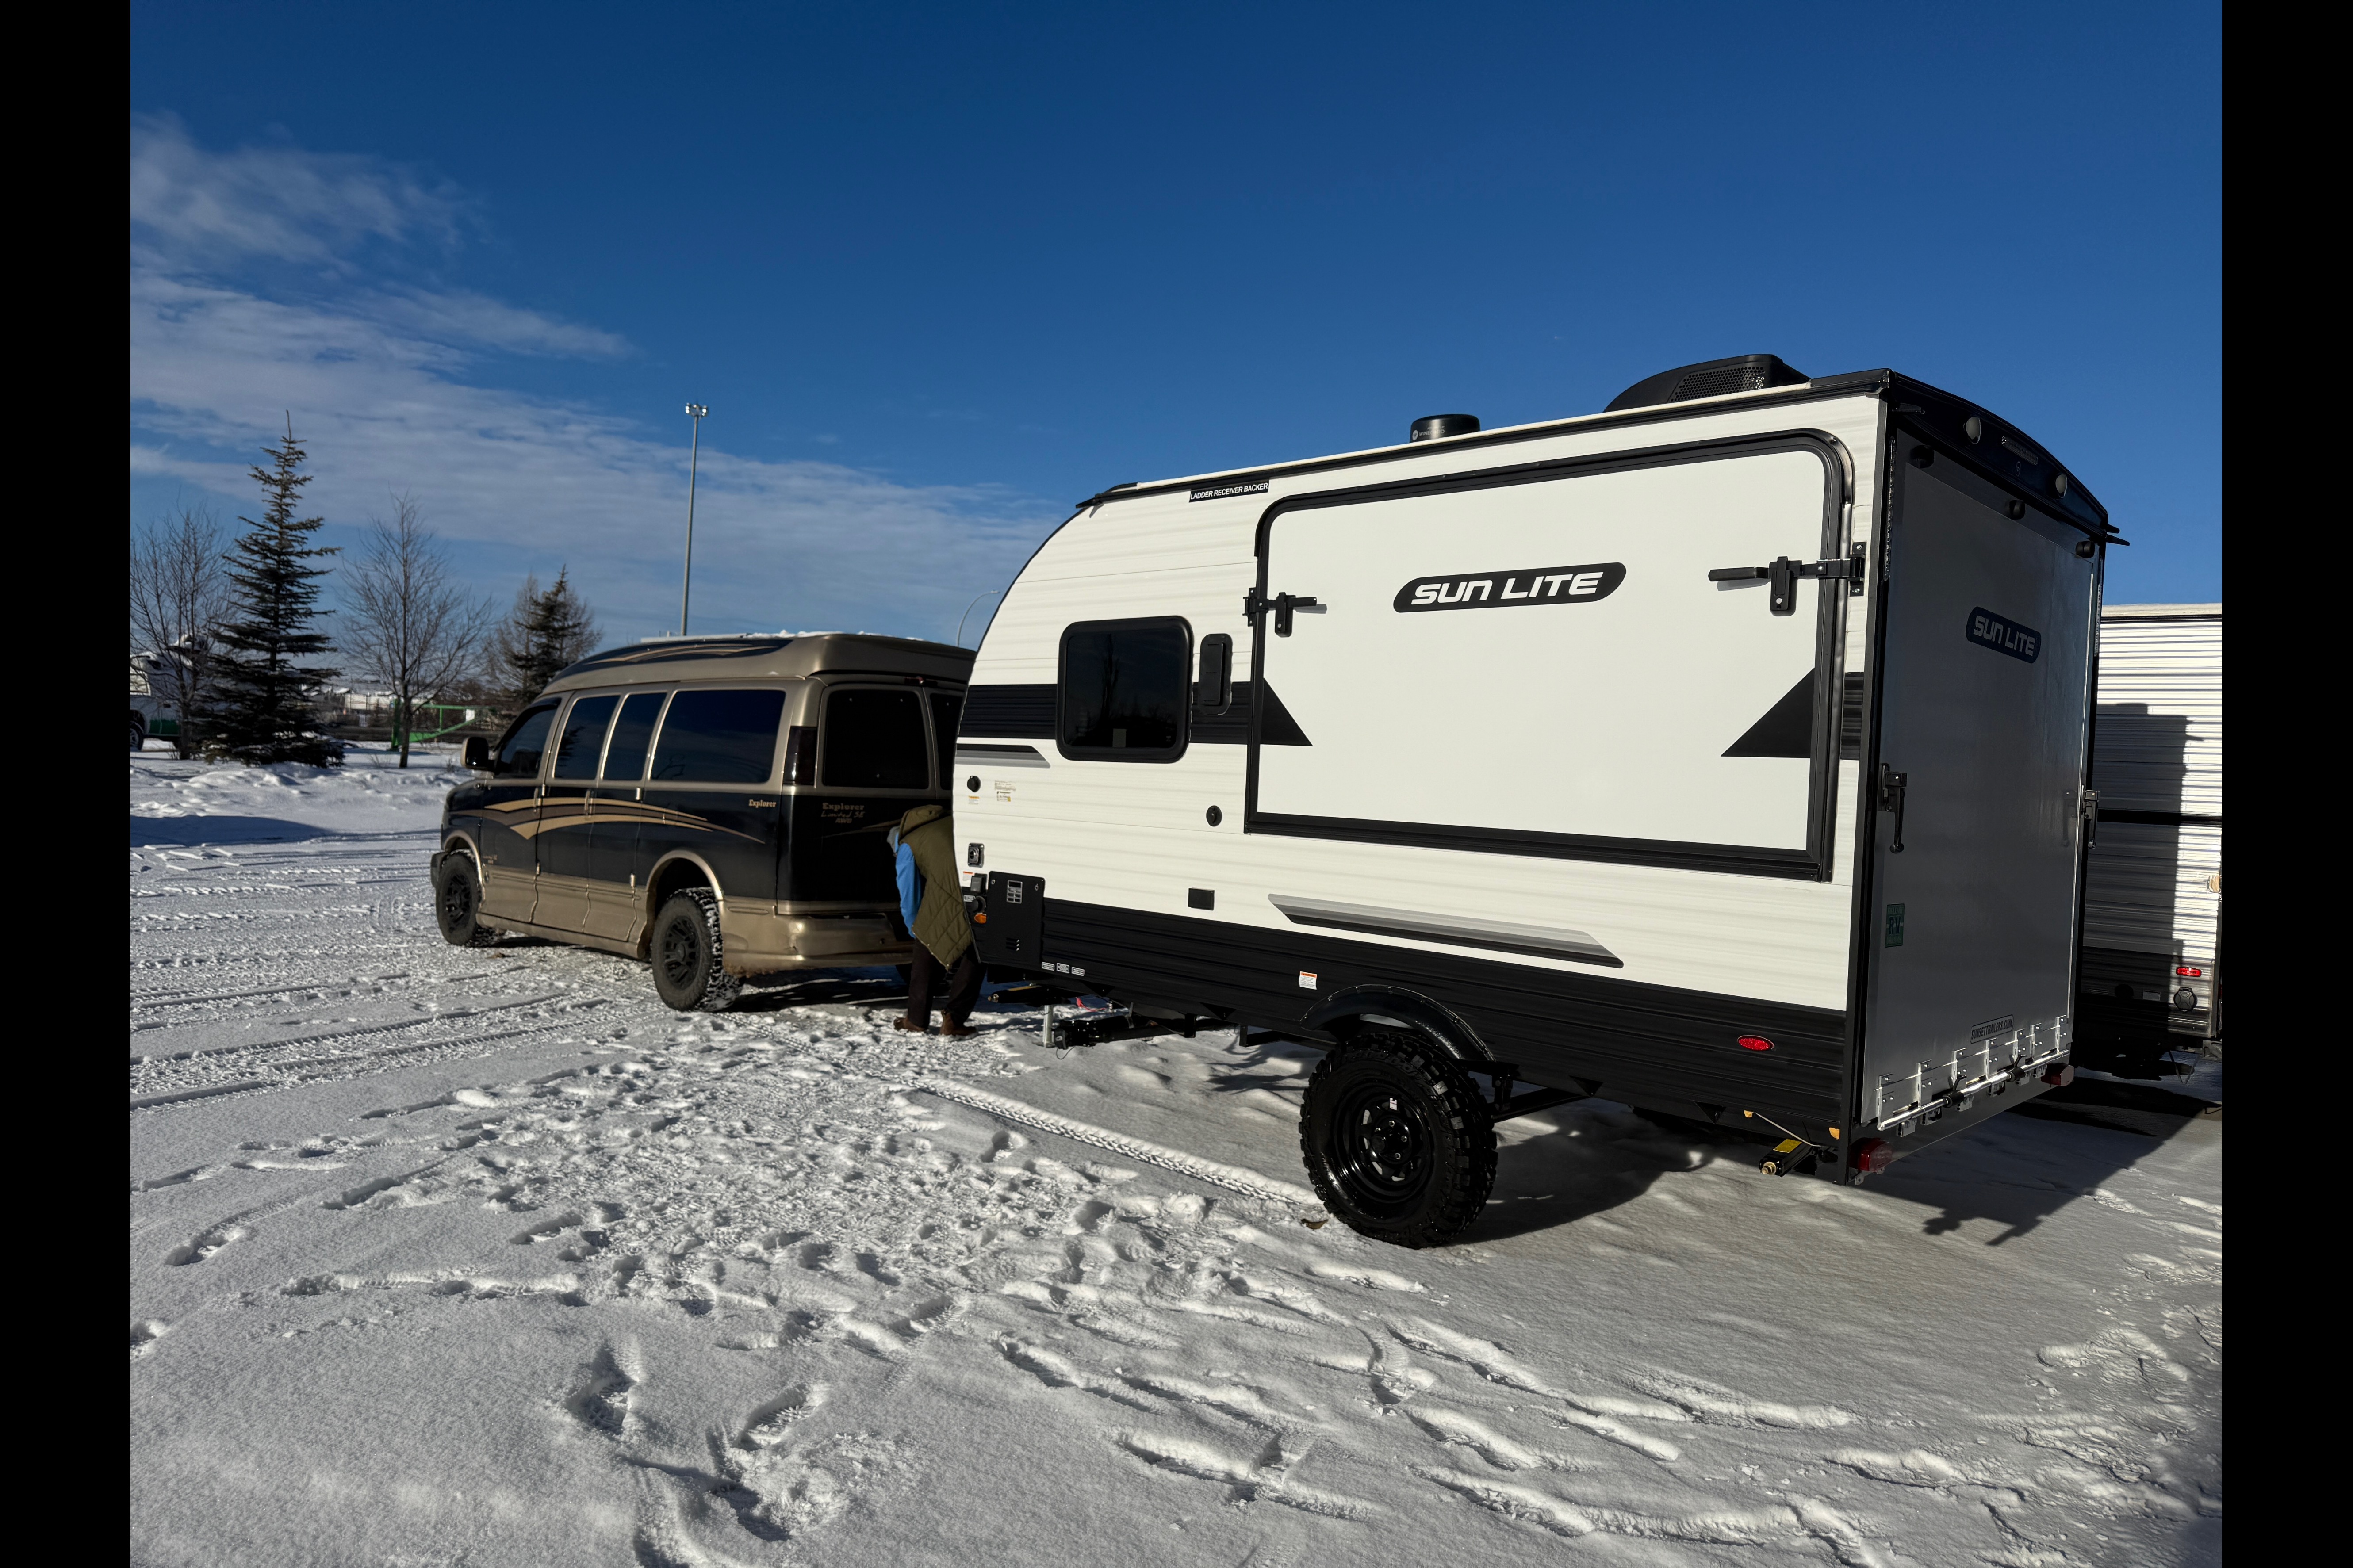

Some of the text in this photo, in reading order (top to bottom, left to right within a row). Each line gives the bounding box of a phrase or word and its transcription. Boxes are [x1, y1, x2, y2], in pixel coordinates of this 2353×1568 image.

[1191, 483, 1268, 500] LADDER RECEIVER BACKER
[1411, 572, 1603, 605] SUN LITE
[1973, 615, 2035, 656] SUN LITE
[748, 799, 776, 808] Explorer
[822, 802, 865, 811] Explorer
[1971, 1018, 2012, 1040] SUNSETTRAILERS.COM
